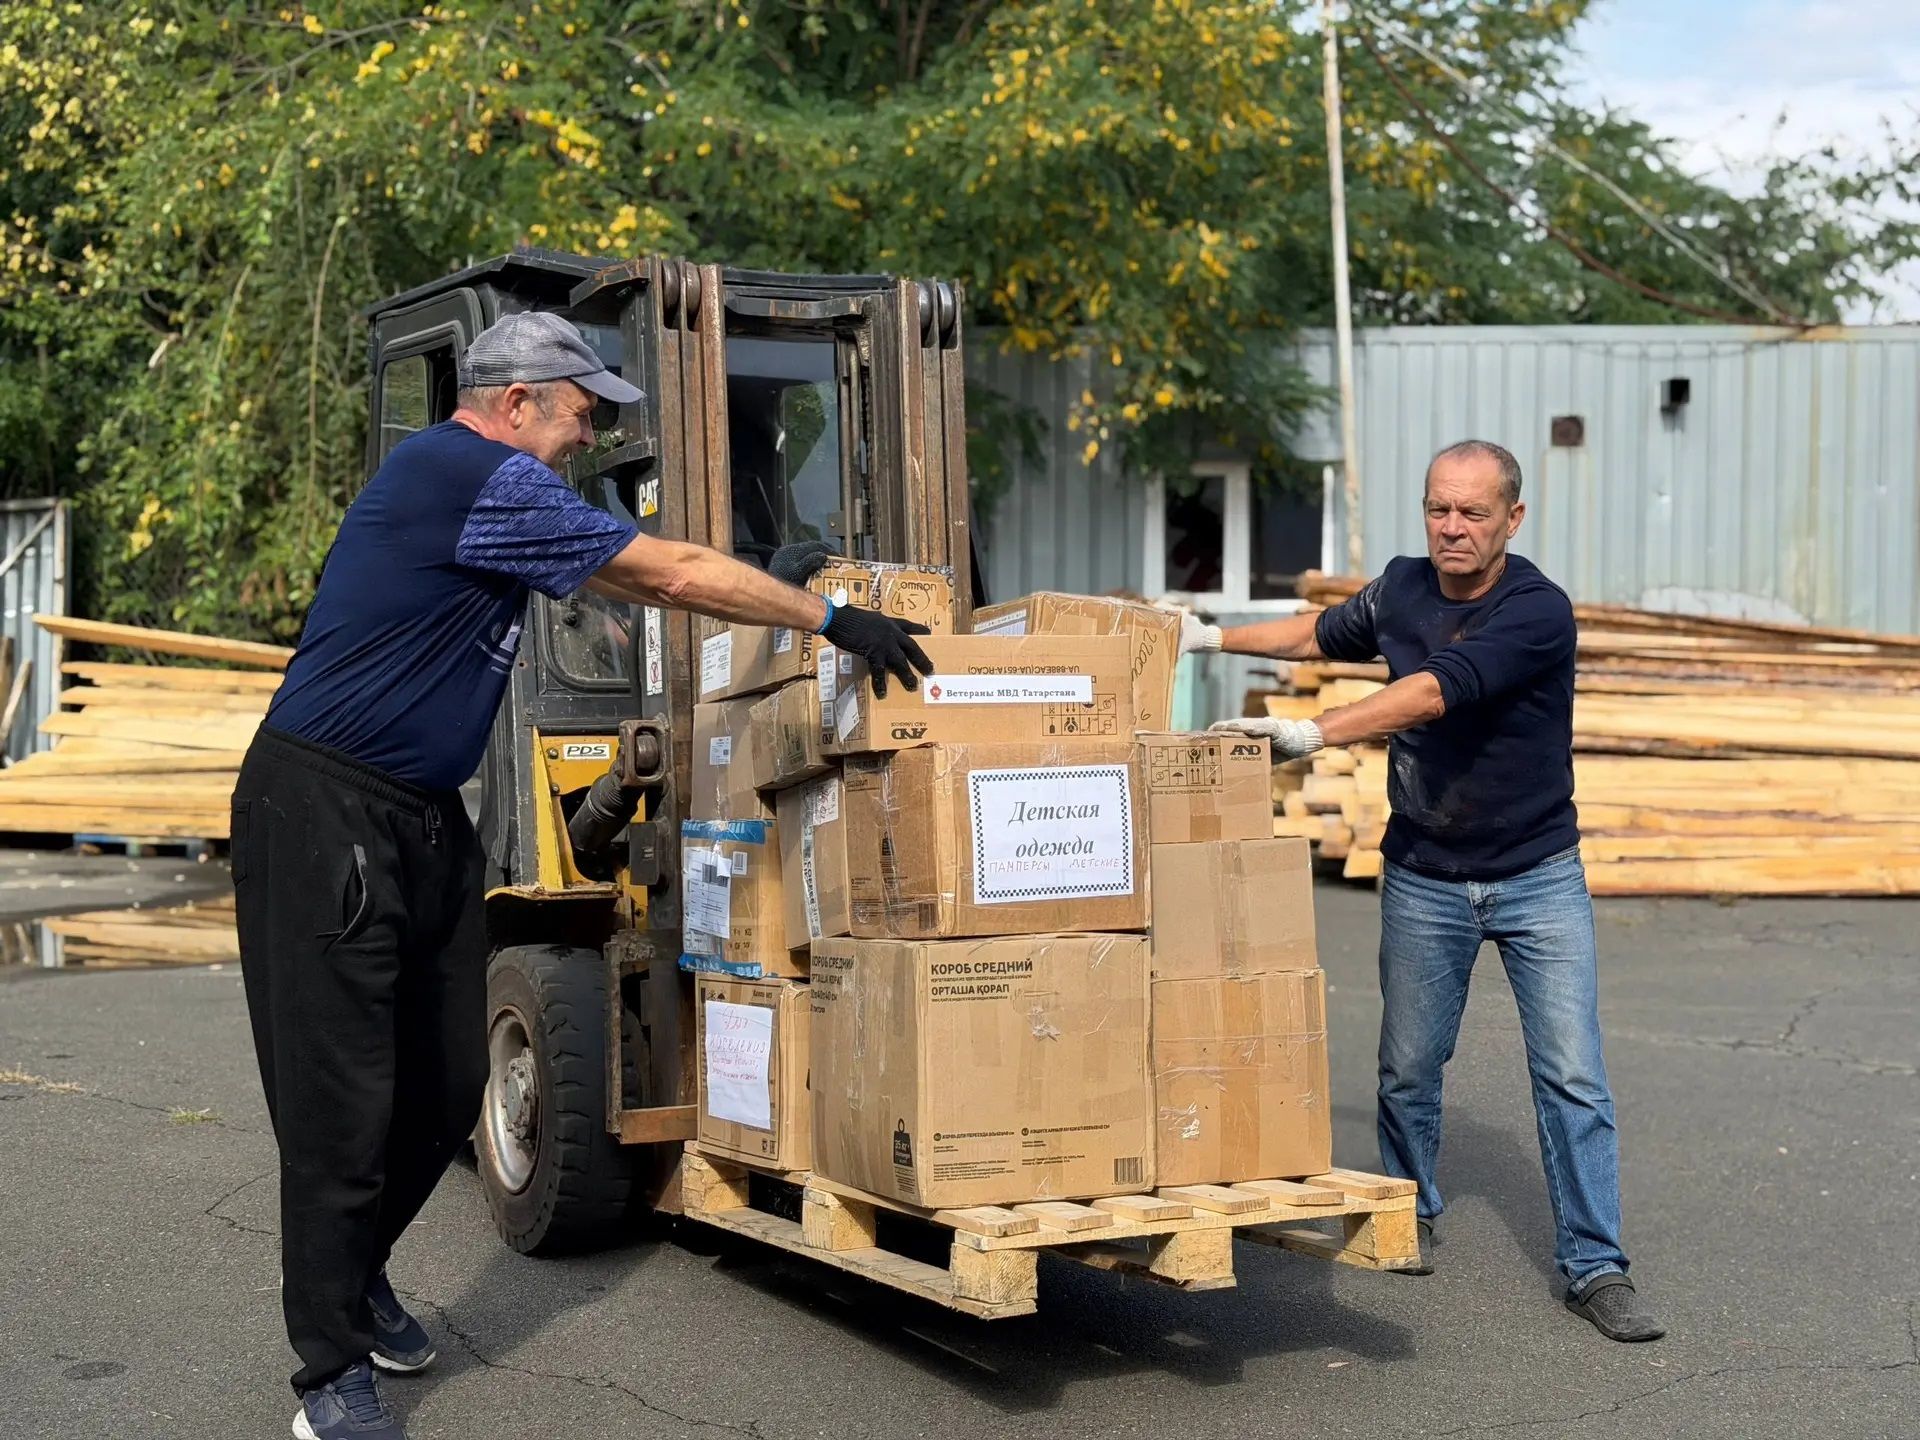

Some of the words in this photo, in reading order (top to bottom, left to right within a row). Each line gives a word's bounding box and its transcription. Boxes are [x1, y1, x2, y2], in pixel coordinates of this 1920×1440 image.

[639, 478, 659, 517] CAT
[946, 689, 994, 699] Ветераны
[996, 688, 1020, 698] МВД
[1022, 688, 1076, 699] Татарстана
[566, 745, 606, 756] PDS
[1007, 801, 1101, 827] Детская
[1015, 835, 1094, 858] одежда
[931, 963, 971, 975] КОРОБ
[973, 958, 1033, 975] СРЕДНИЙ
[931, 985, 975, 996] ОРТАША
